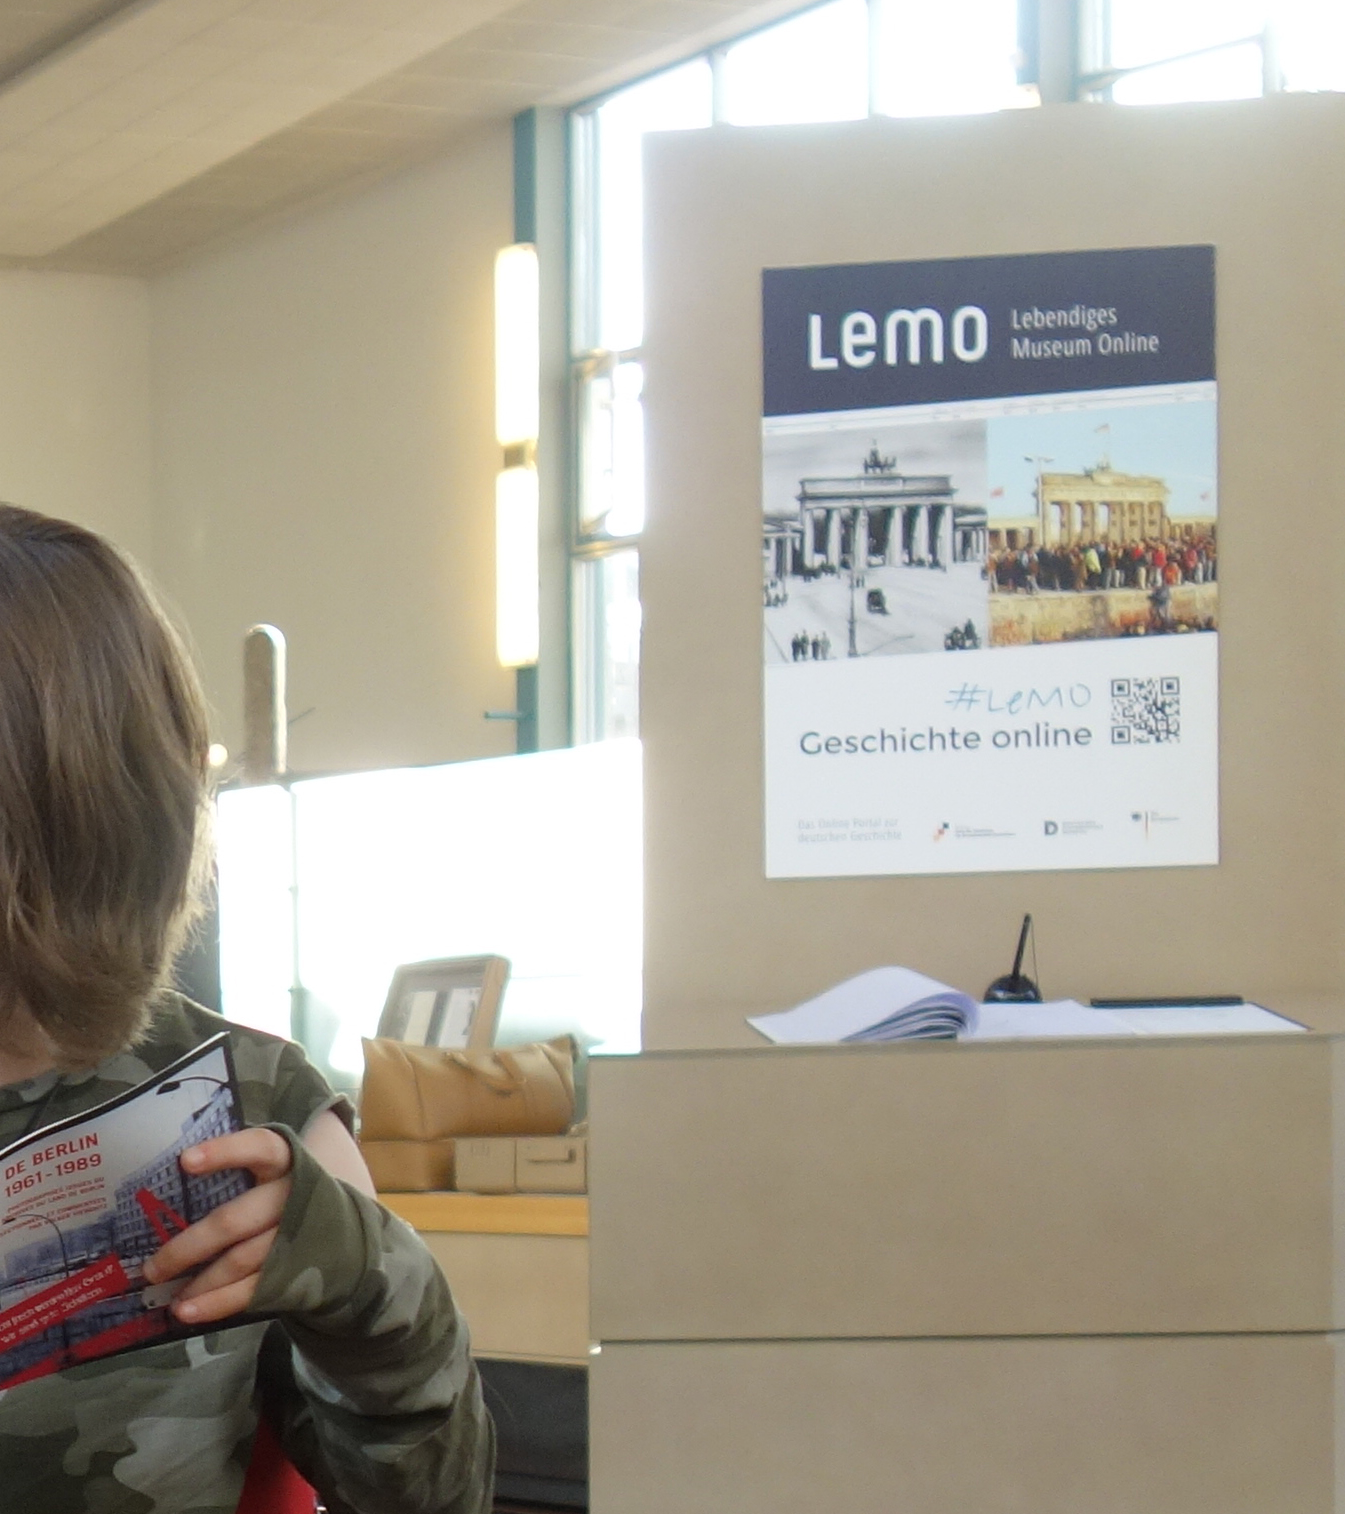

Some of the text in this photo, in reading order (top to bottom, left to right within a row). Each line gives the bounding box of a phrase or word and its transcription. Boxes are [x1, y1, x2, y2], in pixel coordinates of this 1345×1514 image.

[1012, 305, 1118, 331] Lebendiges
[1012, 332, 1160, 360] Museum Online
[799, 721, 1093, 756] Geschichte online
[5, 1160, 27, 1181] DE
[32, 1133, 99, 1166] BERLIN
